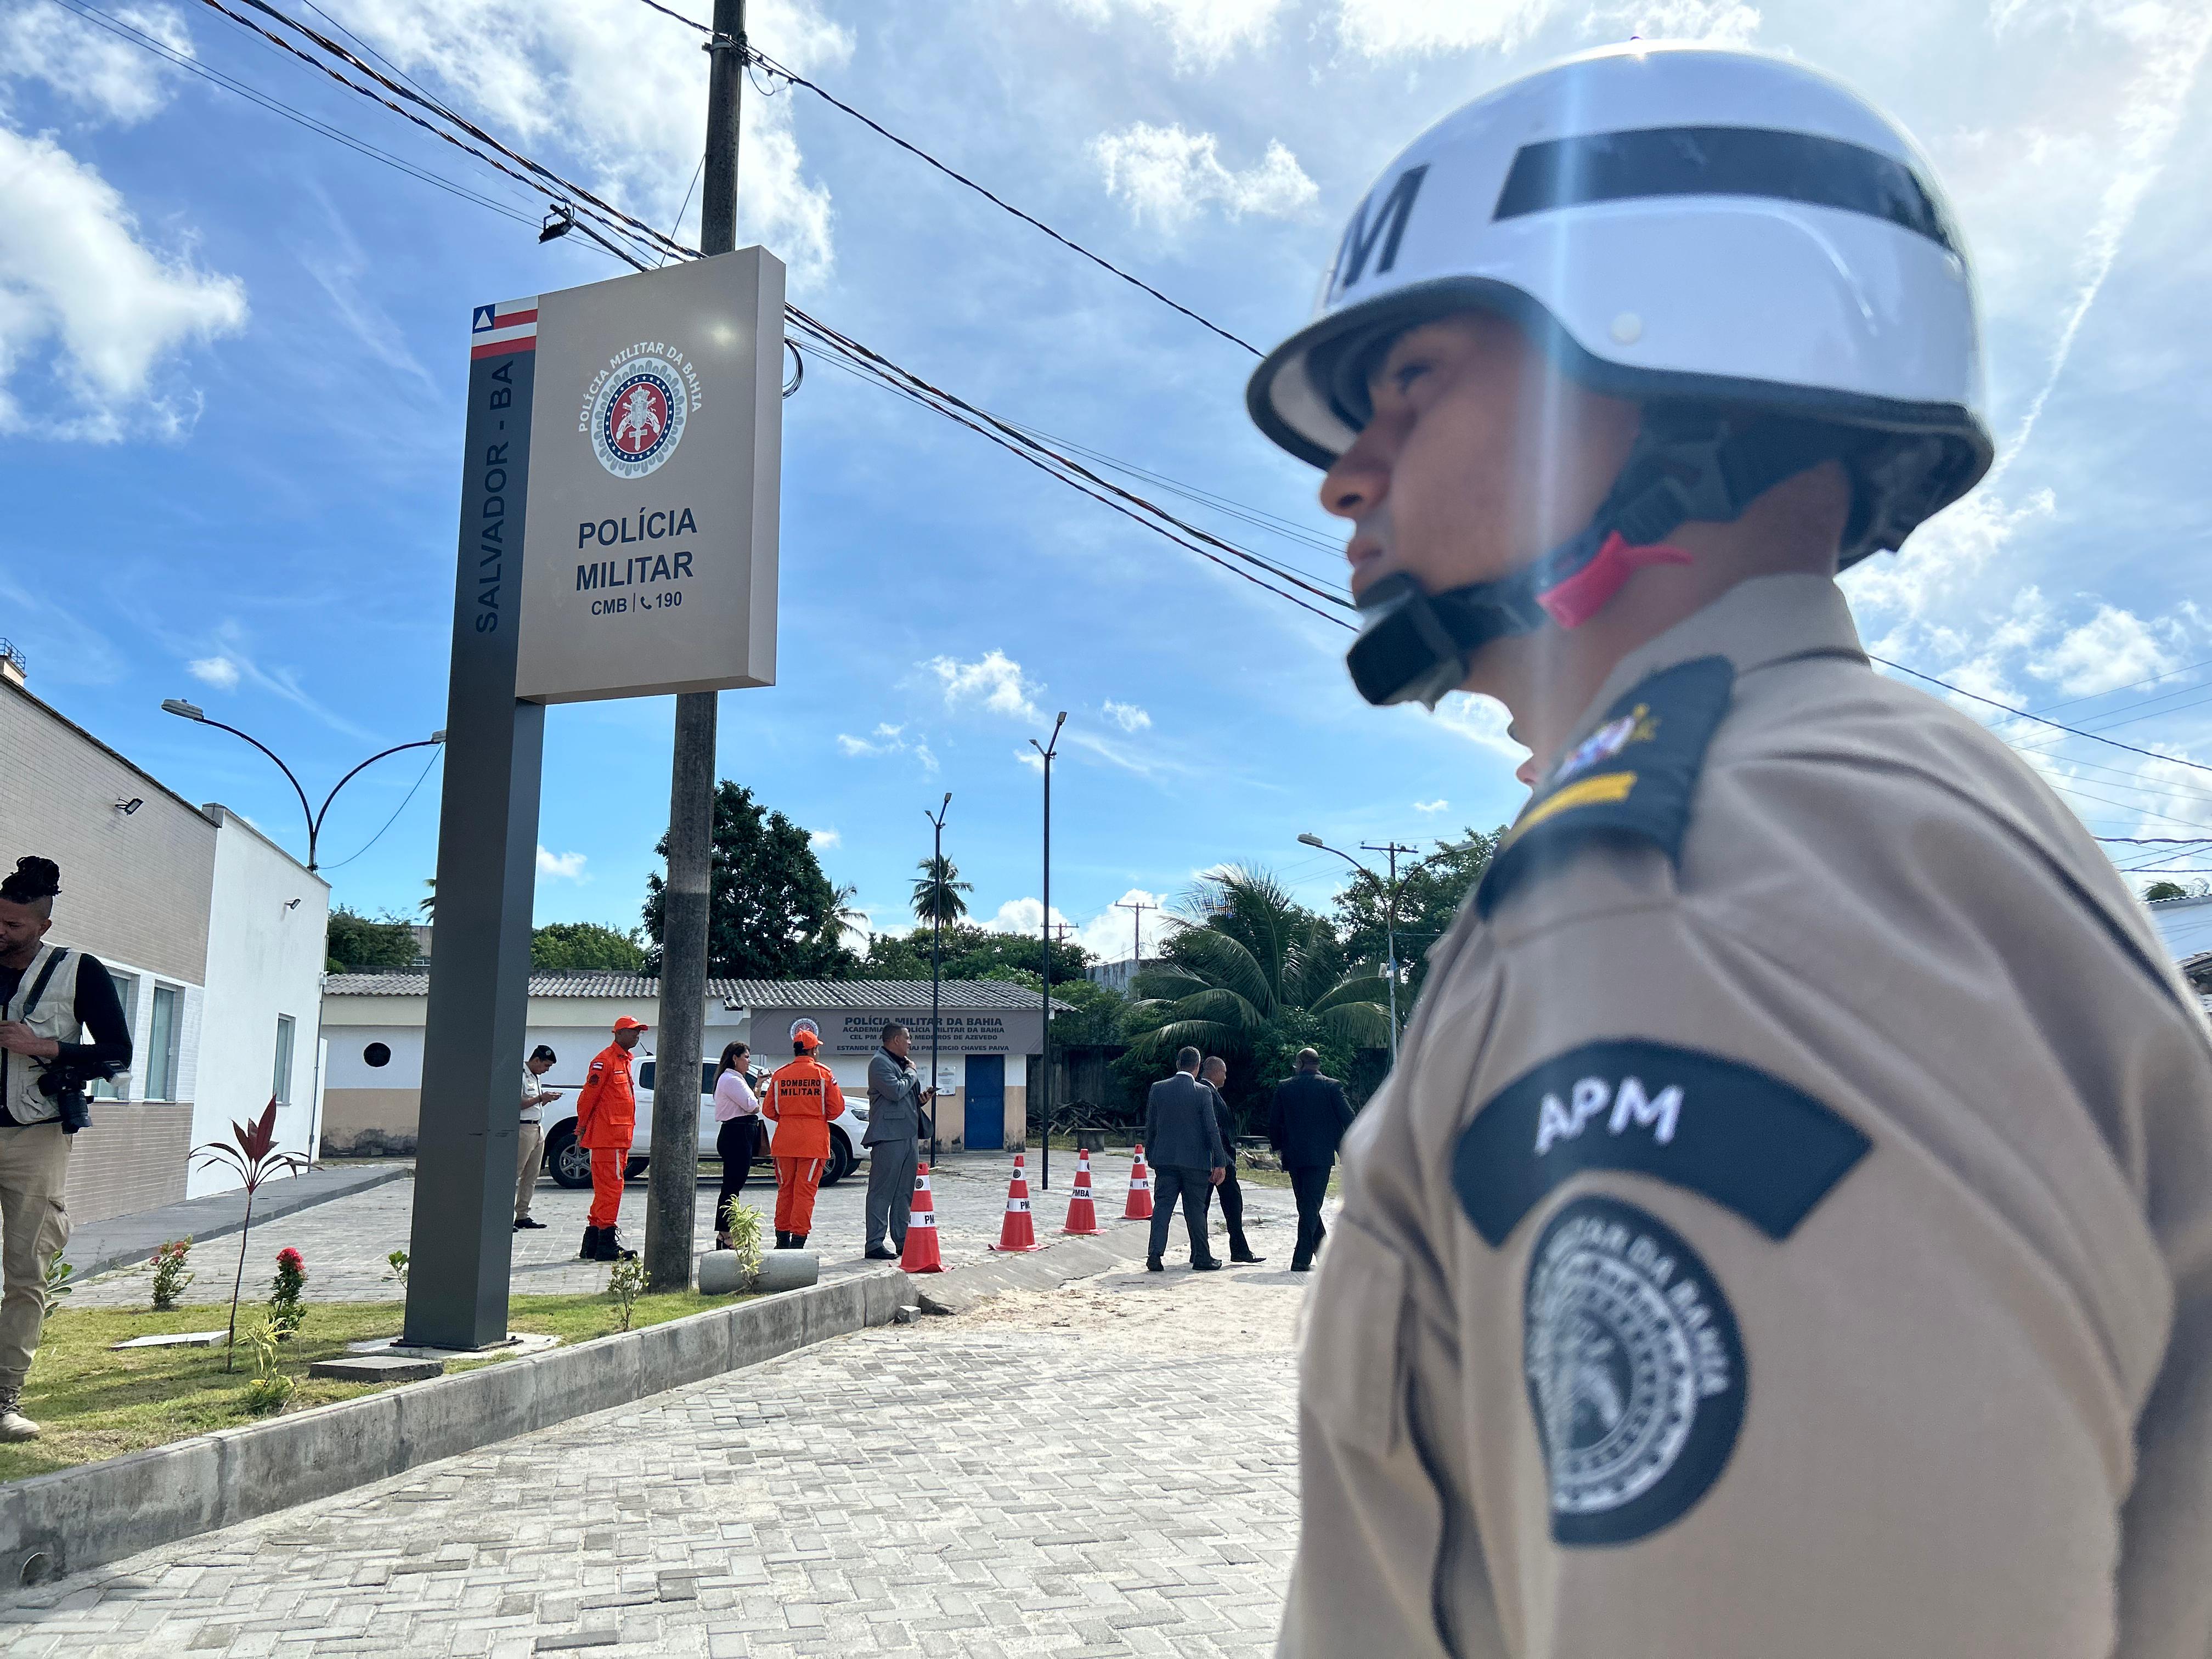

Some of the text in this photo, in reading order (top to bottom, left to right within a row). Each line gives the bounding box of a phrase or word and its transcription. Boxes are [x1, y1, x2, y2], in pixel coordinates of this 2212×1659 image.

[489, 359, 514, 410] BA
[578, 341, 702, 432] POLÍCIA MILITAR DA BAHIA
[475, 441, 509, 633] SALVADOR
[578, 506, 698, 549] POLÍCIA
[576, 551, 694, 591] MILITAR
[591, 591, 682, 616] CMB 190
[845, 1015, 890, 1025] POLÍCIA
[946, 1018, 963, 1026] DA
[967, 1018, 1003, 1026] BAHIA
[1534, 1076, 1684, 1156] APM
